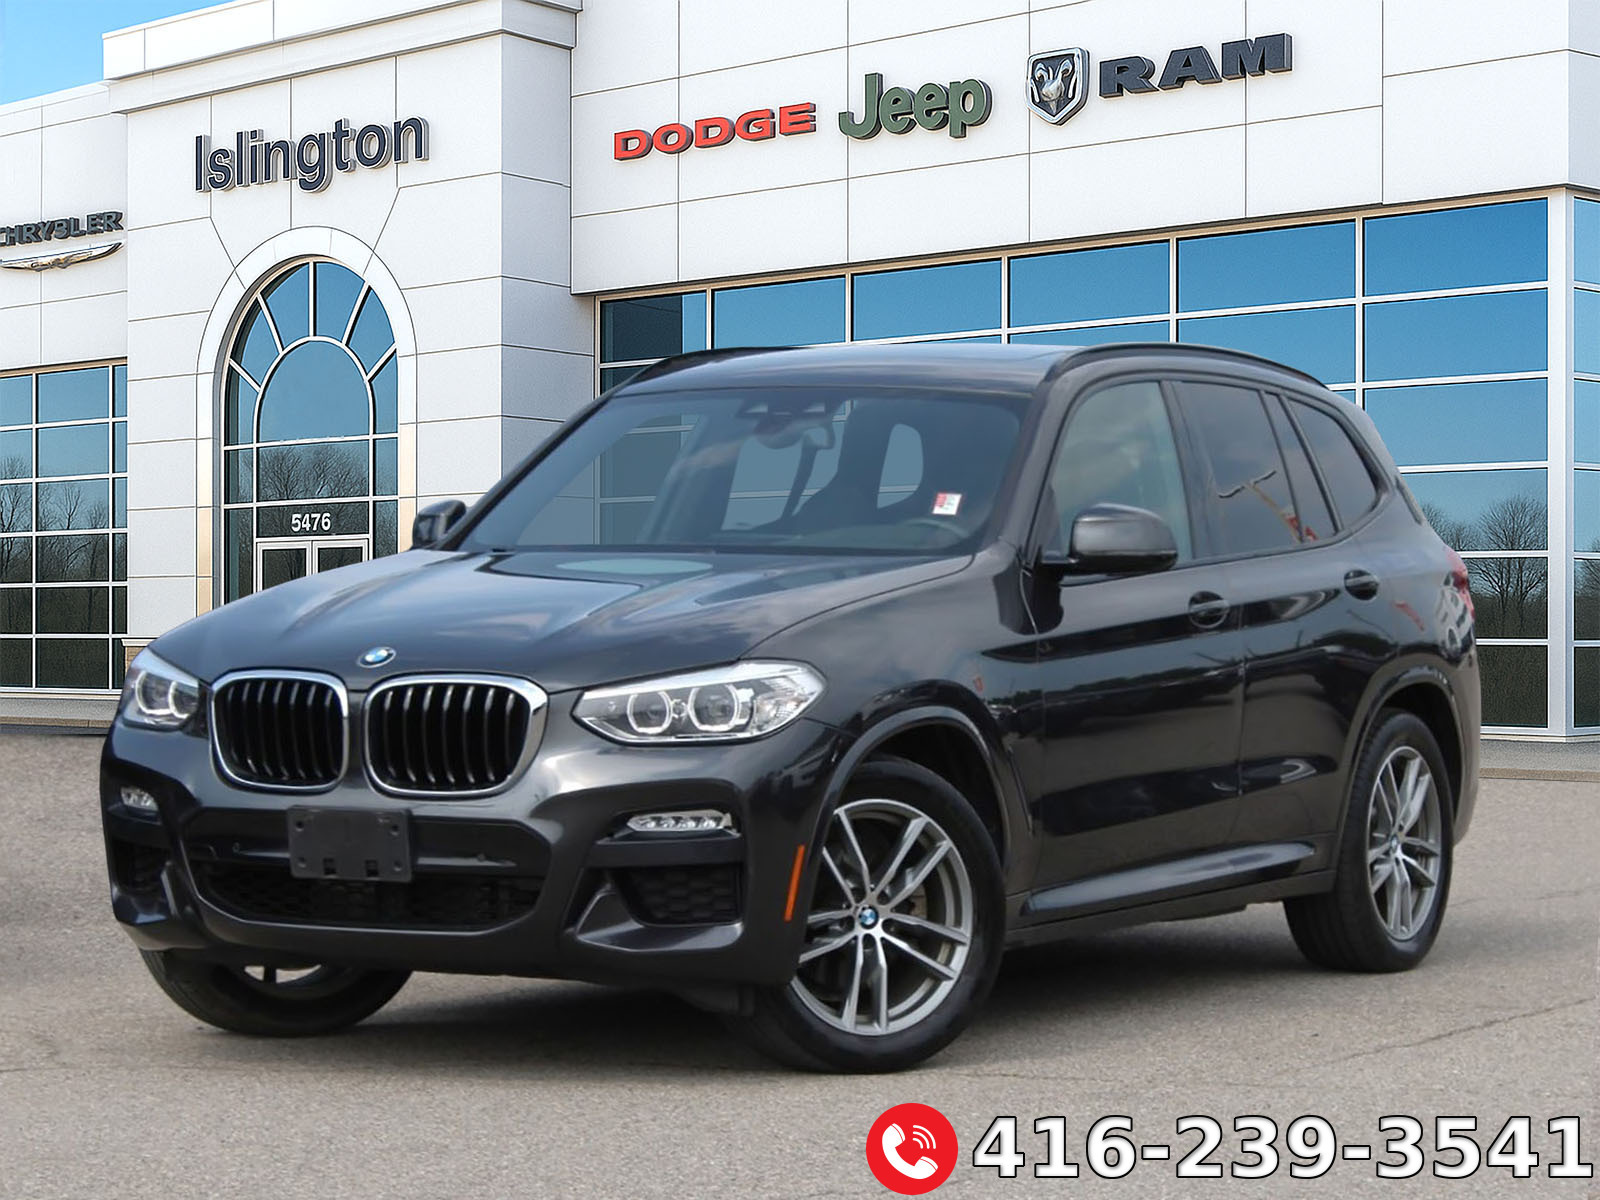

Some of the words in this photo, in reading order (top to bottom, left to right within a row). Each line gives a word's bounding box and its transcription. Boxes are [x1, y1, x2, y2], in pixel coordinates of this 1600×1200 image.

[1099, 32, 1294, 99] RAM
[613, 101, 817, 161] DODGE
[838, 72, 992, 139] Jeep
[194, 115, 429, 193] Islington
[291, 512, 331, 532] 5476
